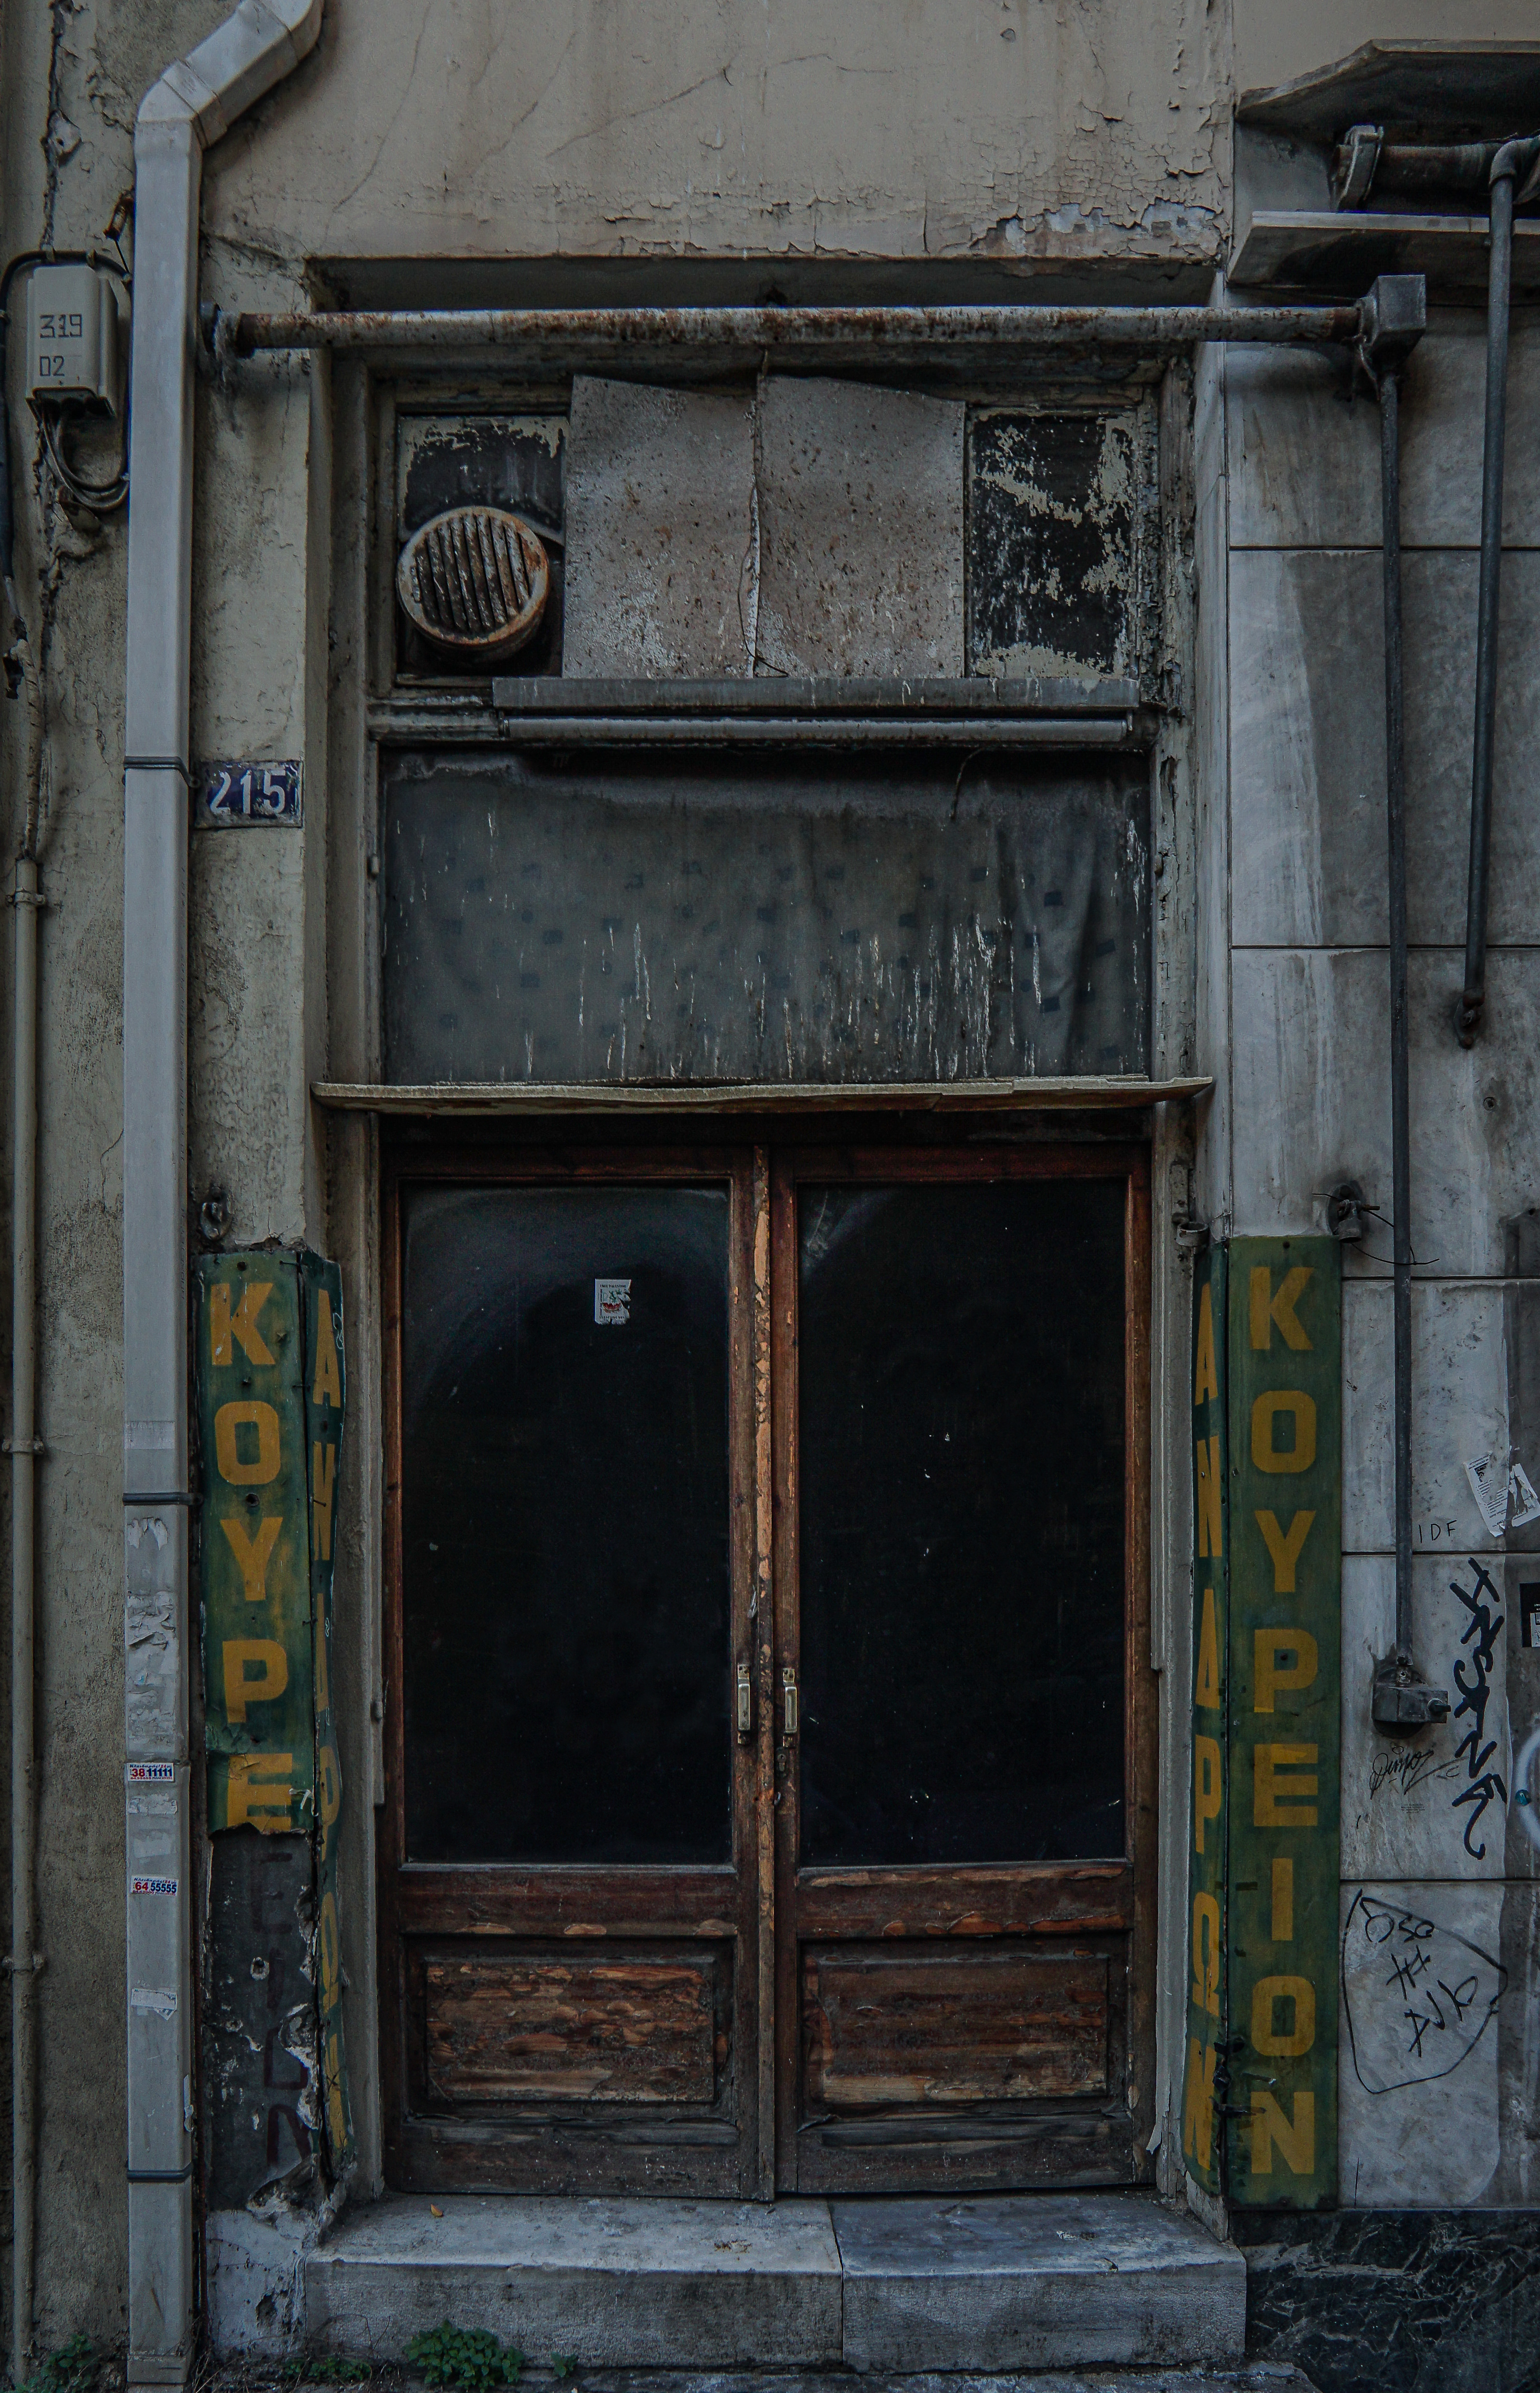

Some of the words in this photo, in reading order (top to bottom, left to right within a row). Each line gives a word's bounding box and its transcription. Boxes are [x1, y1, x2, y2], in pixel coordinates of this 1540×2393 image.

[40, 314, 82, 339] 319
[40, 355, 65, 376] 02
[210, 766, 286, 815] 215
[1418, 1520, 1458, 1543] IDF
